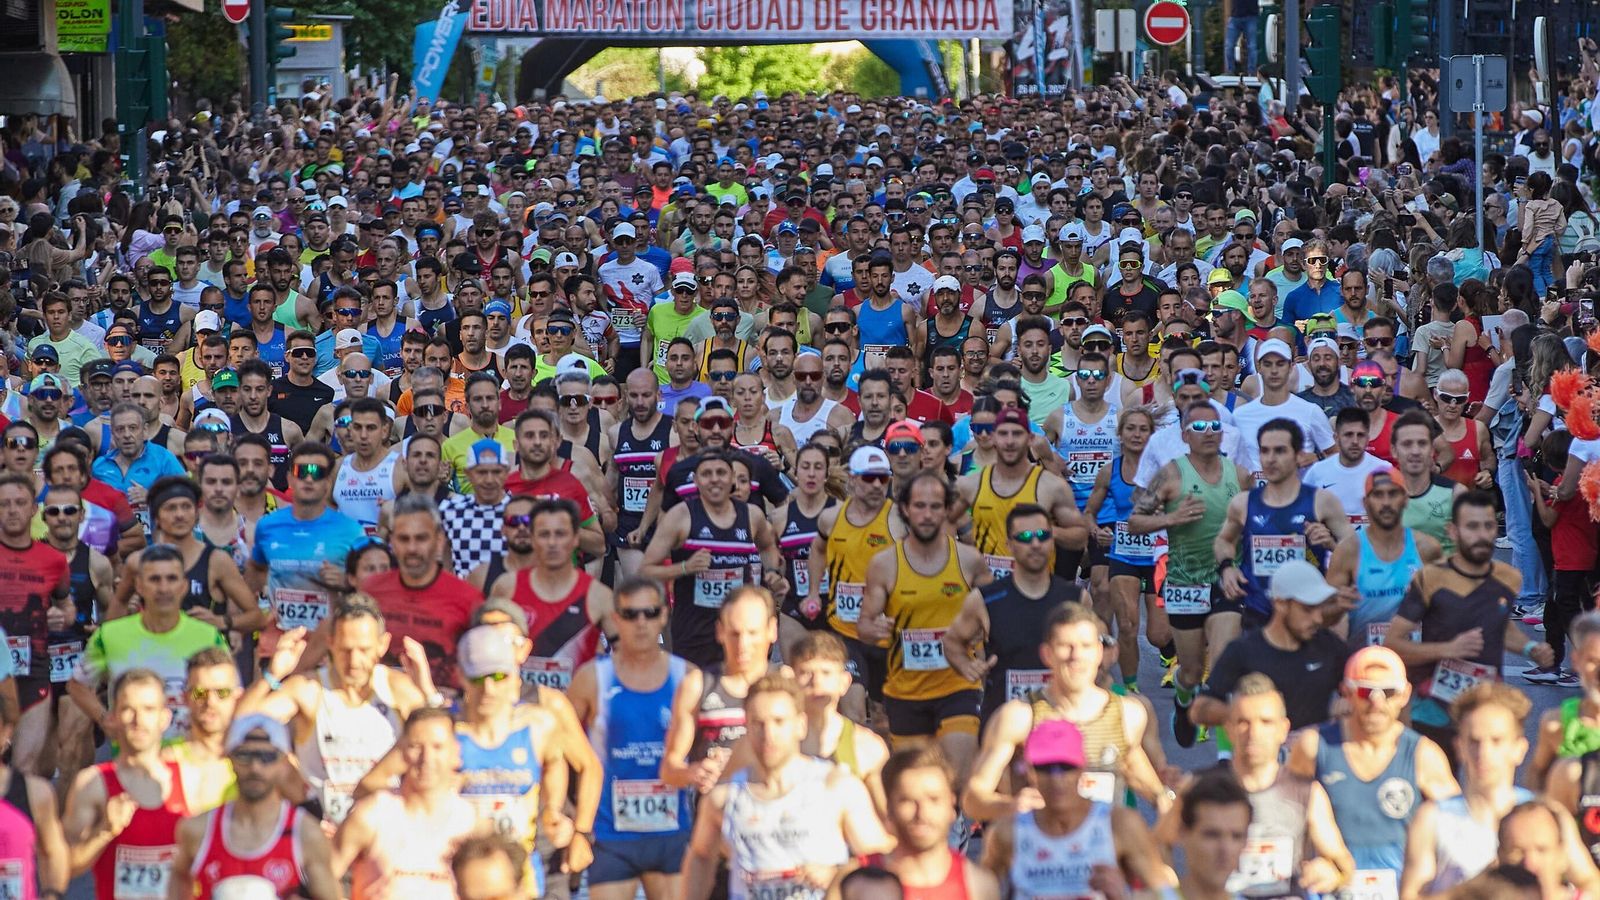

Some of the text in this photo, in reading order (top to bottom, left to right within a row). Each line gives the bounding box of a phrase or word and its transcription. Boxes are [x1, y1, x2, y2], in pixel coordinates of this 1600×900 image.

[56, 9, 104, 19] OLON
[696, 0, 804, 31] CIUDAD
[814, 0, 851, 31] DE
[861, 0, 1000, 31] GRANADA
[1070, 438, 1113, 446] MARACENA
[340, 488, 384, 498] MARACENA
[1117, 533, 1151, 547] 3346
[1254, 549, 1298, 564] 2468
[1166, 588, 1202, 603] 2842
[278, 603, 320, 619] 4627
[911, 642, 943, 658] 821
[520, 671, 562, 689] 599
[617, 798, 669, 817] 2104
